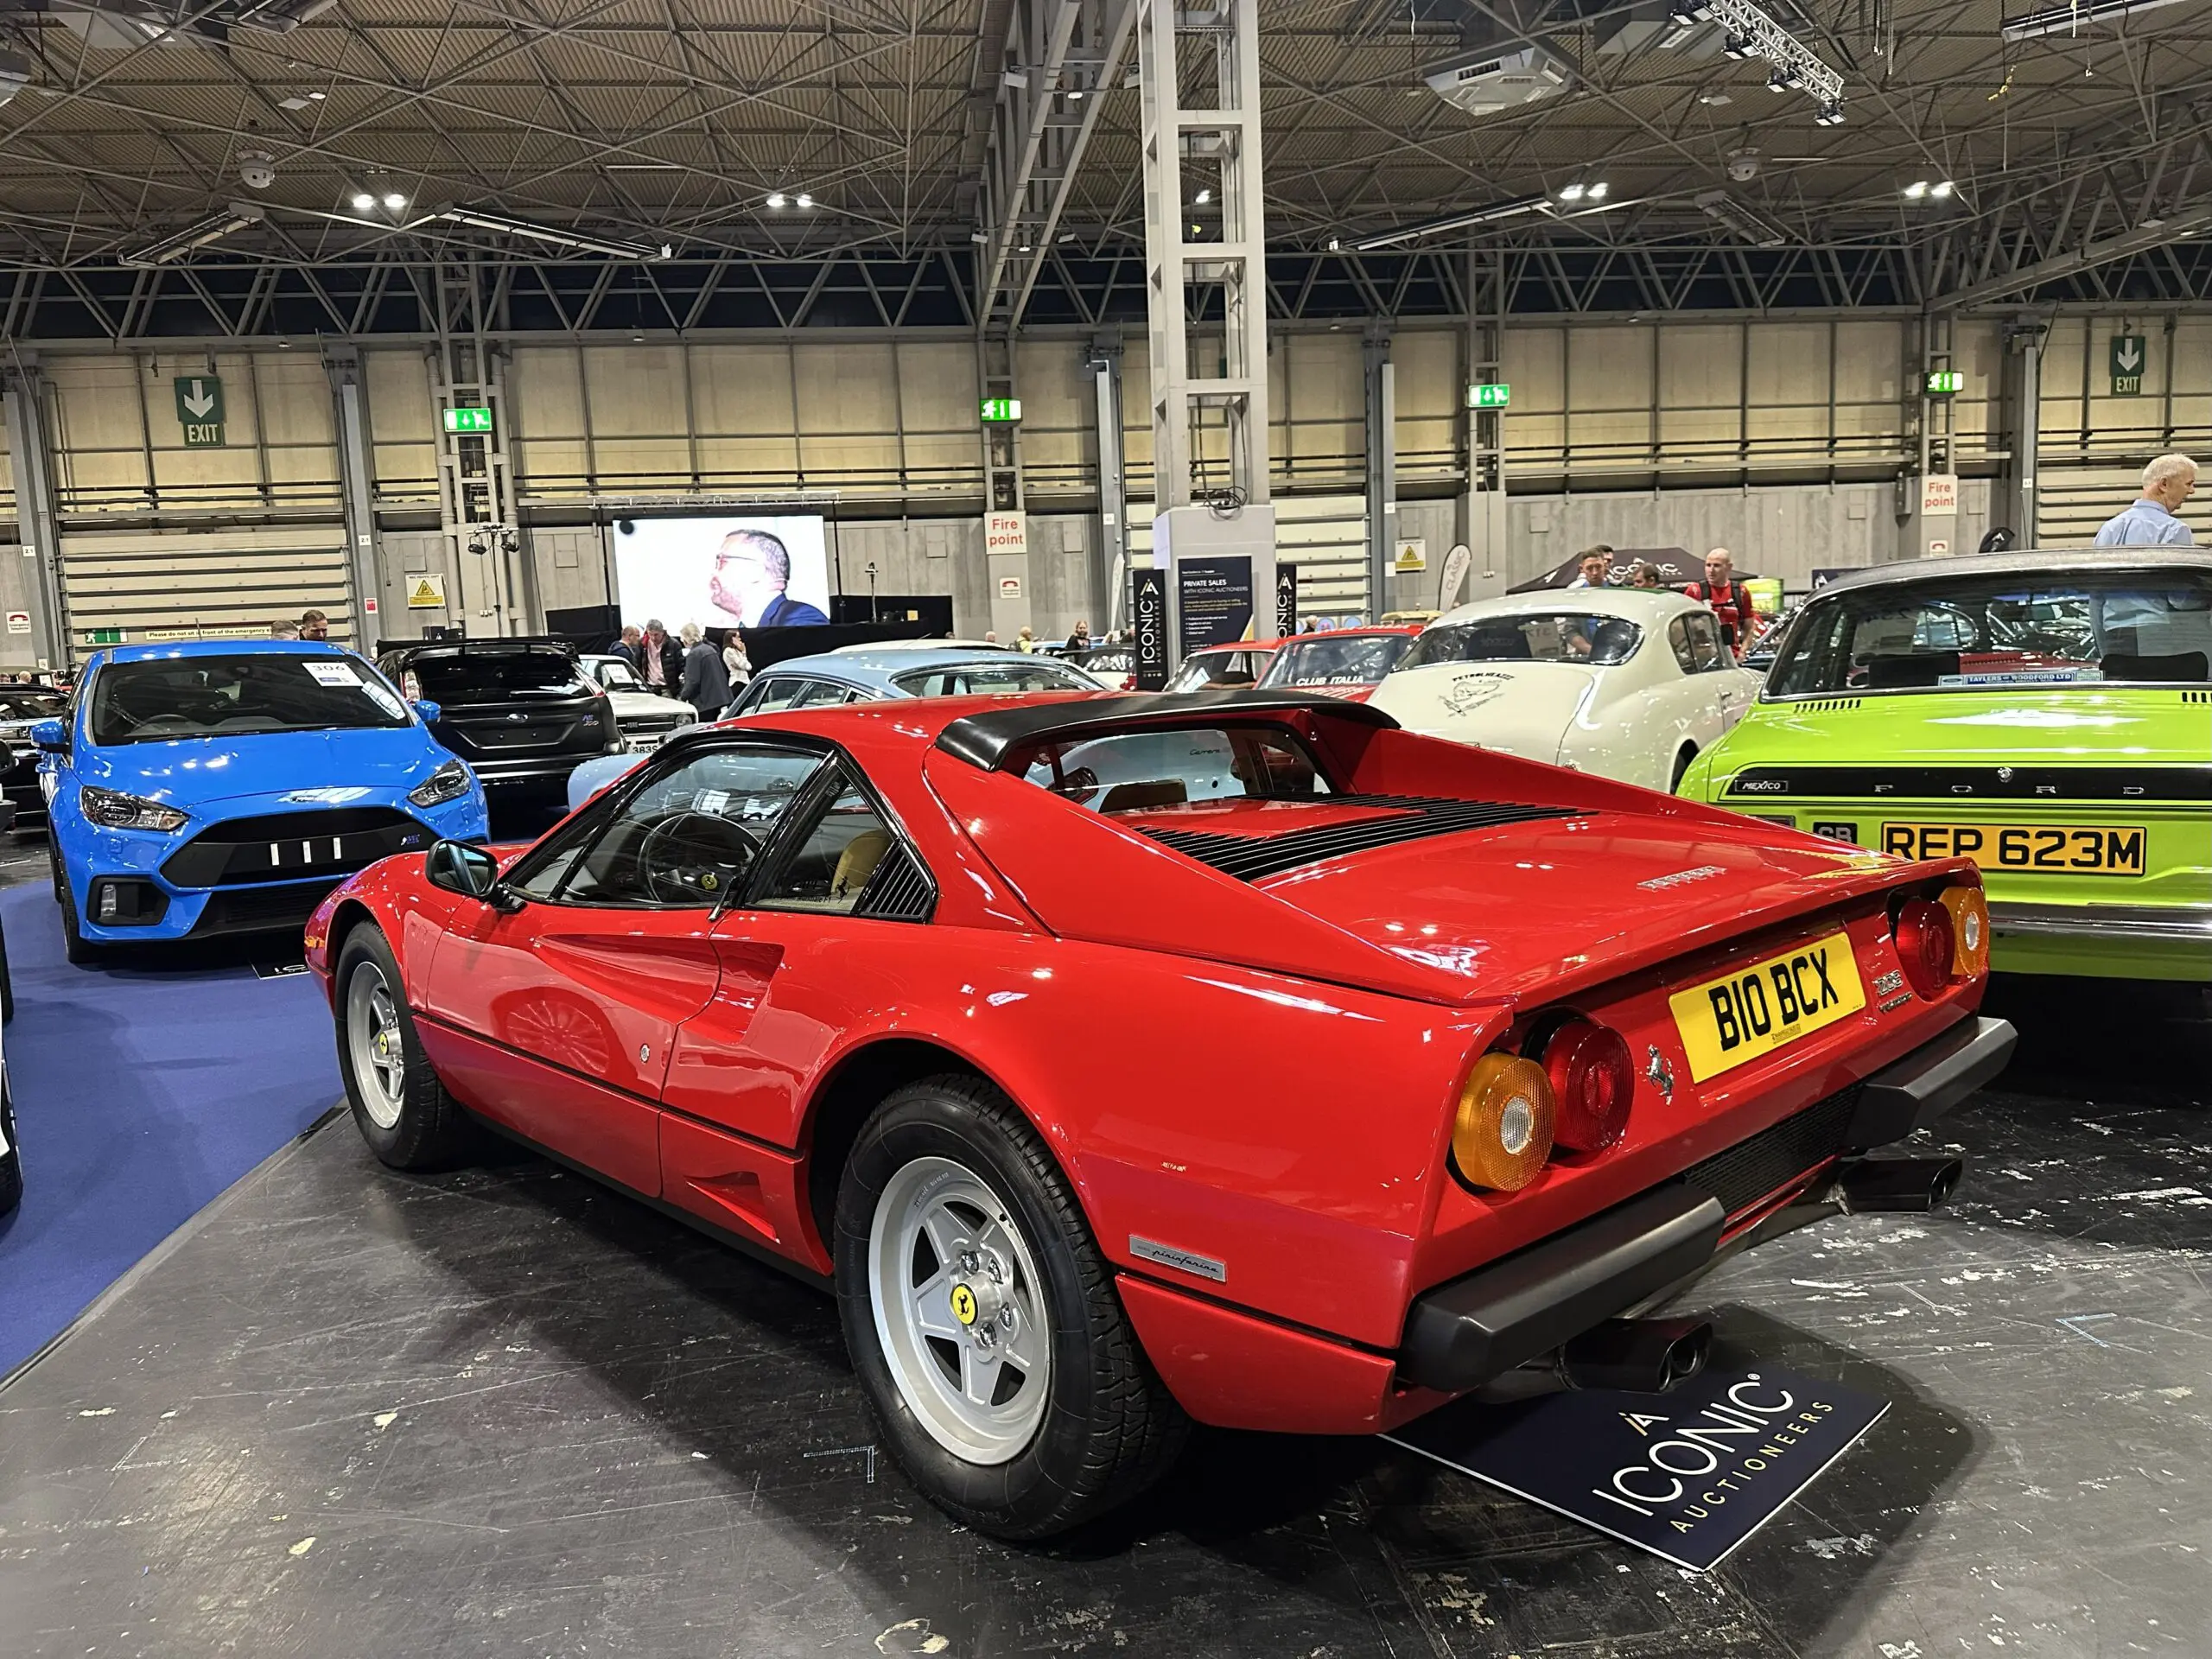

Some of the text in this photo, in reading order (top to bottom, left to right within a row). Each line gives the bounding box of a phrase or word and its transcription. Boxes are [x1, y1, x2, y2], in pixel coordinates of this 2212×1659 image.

[2116, 376, 2139, 392] EXIT
[188, 423, 218, 442] EXIT
[1928, 481, 1951, 493] Fire
[1924, 496, 1955, 509] point
[992, 518, 1018, 530] Fire
[989, 533, 1023, 547] point
[1609, 563, 1679, 575] ICOIC
[1277, 594, 1287, 639] ONIC
[1296, 675, 1363, 686] CLUB ITALIA
[1742, 780, 1781, 791] MEXICO
[1885, 826, 2141, 869] REP 623M
[1769, 948, 1840, 1026] BCX
[1152, 1249, 1219, 1273] pininfarina
[1669, 1401, 1834, 1535] AUCTIONEERS
